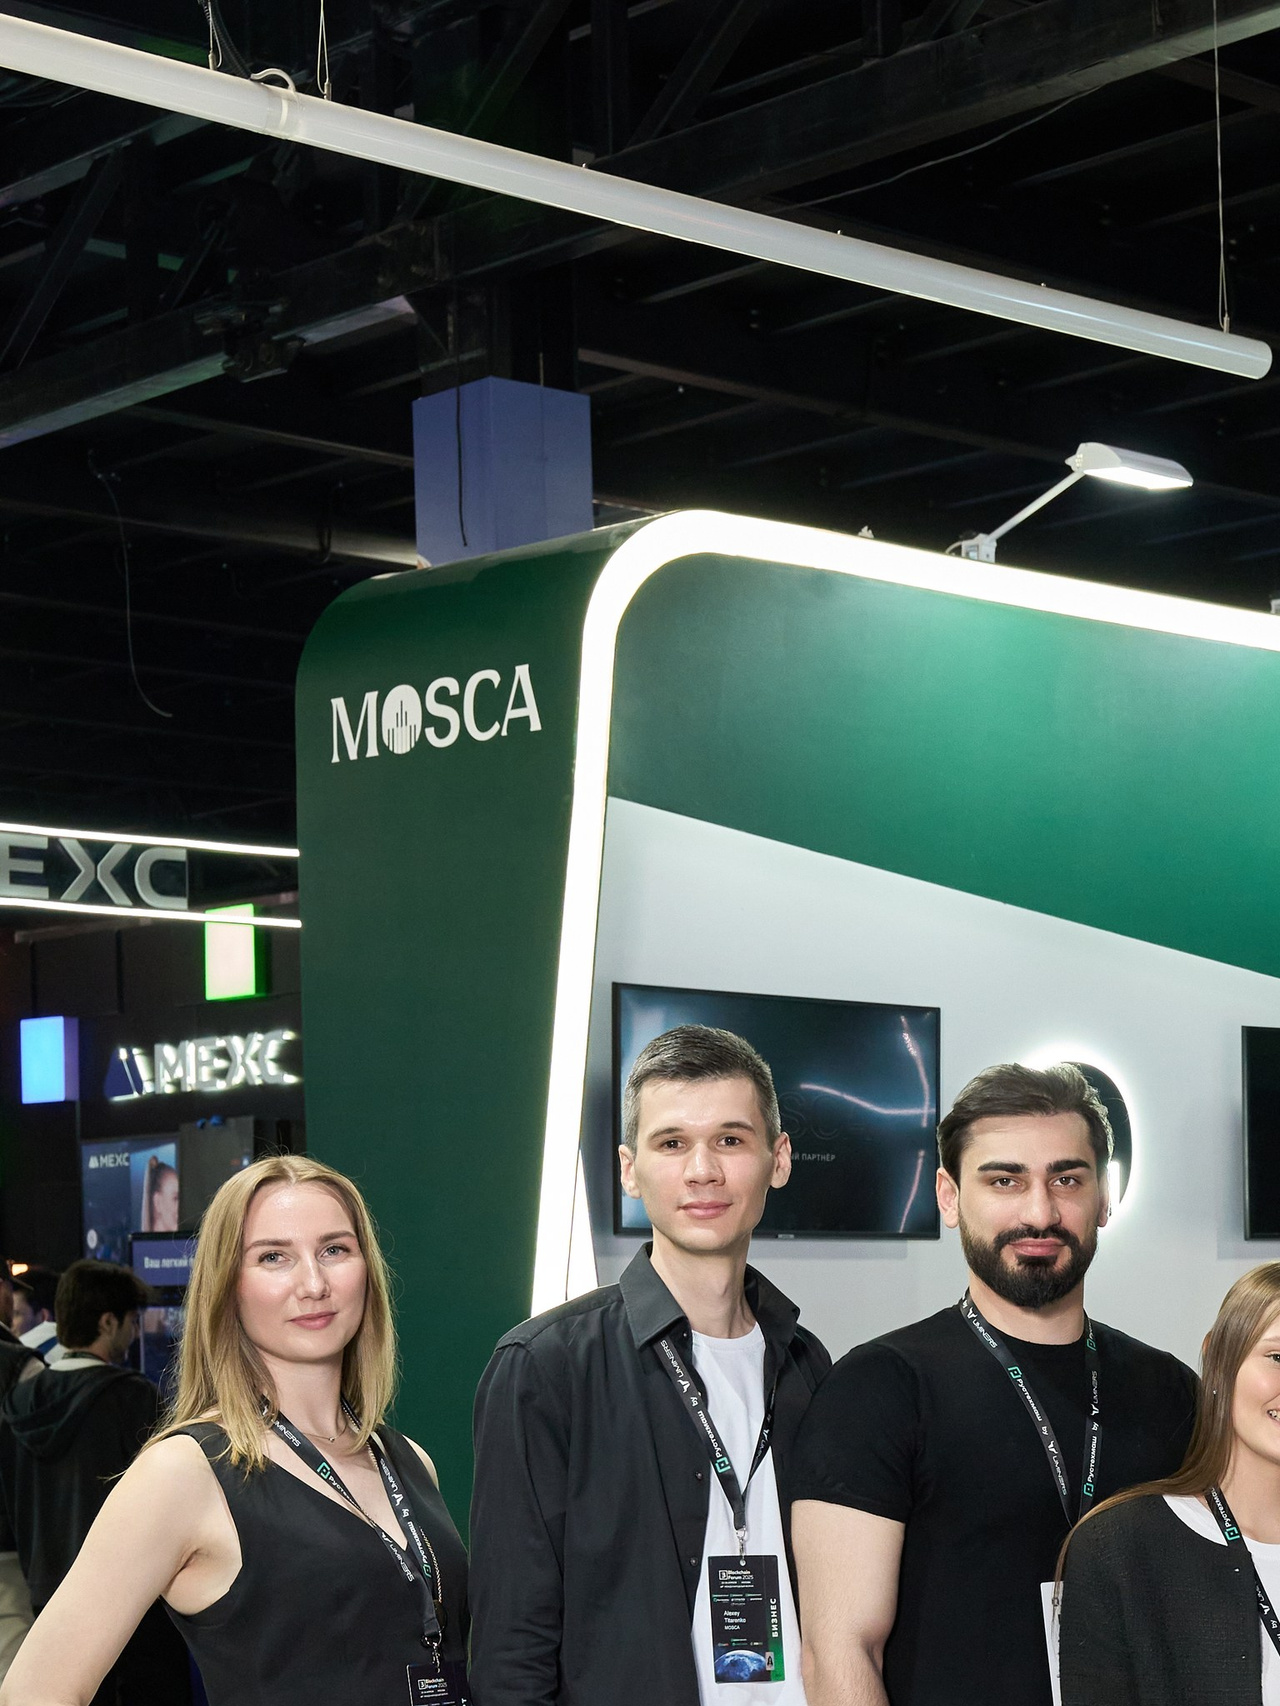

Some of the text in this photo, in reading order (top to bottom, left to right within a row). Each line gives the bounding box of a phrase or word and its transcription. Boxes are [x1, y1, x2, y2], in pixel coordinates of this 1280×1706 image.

[331, 664, 542, 763] MOSCA
[0, 833, 188, 911] EXC
[154, 1028, 300, 1095] MEXC
[100, 1153, 129, 1168] MEXC
[660, 1339, 684, 1379] UMINERS
[690, 1396, 698, 1407] by
[274, 1420, 301, 1447] MINERS
[1041, 1426, 1049, 1436] by
[1091, 1422, 1099, 1431] by
[770, 1598, 779, 1638] БИЗНЕС
